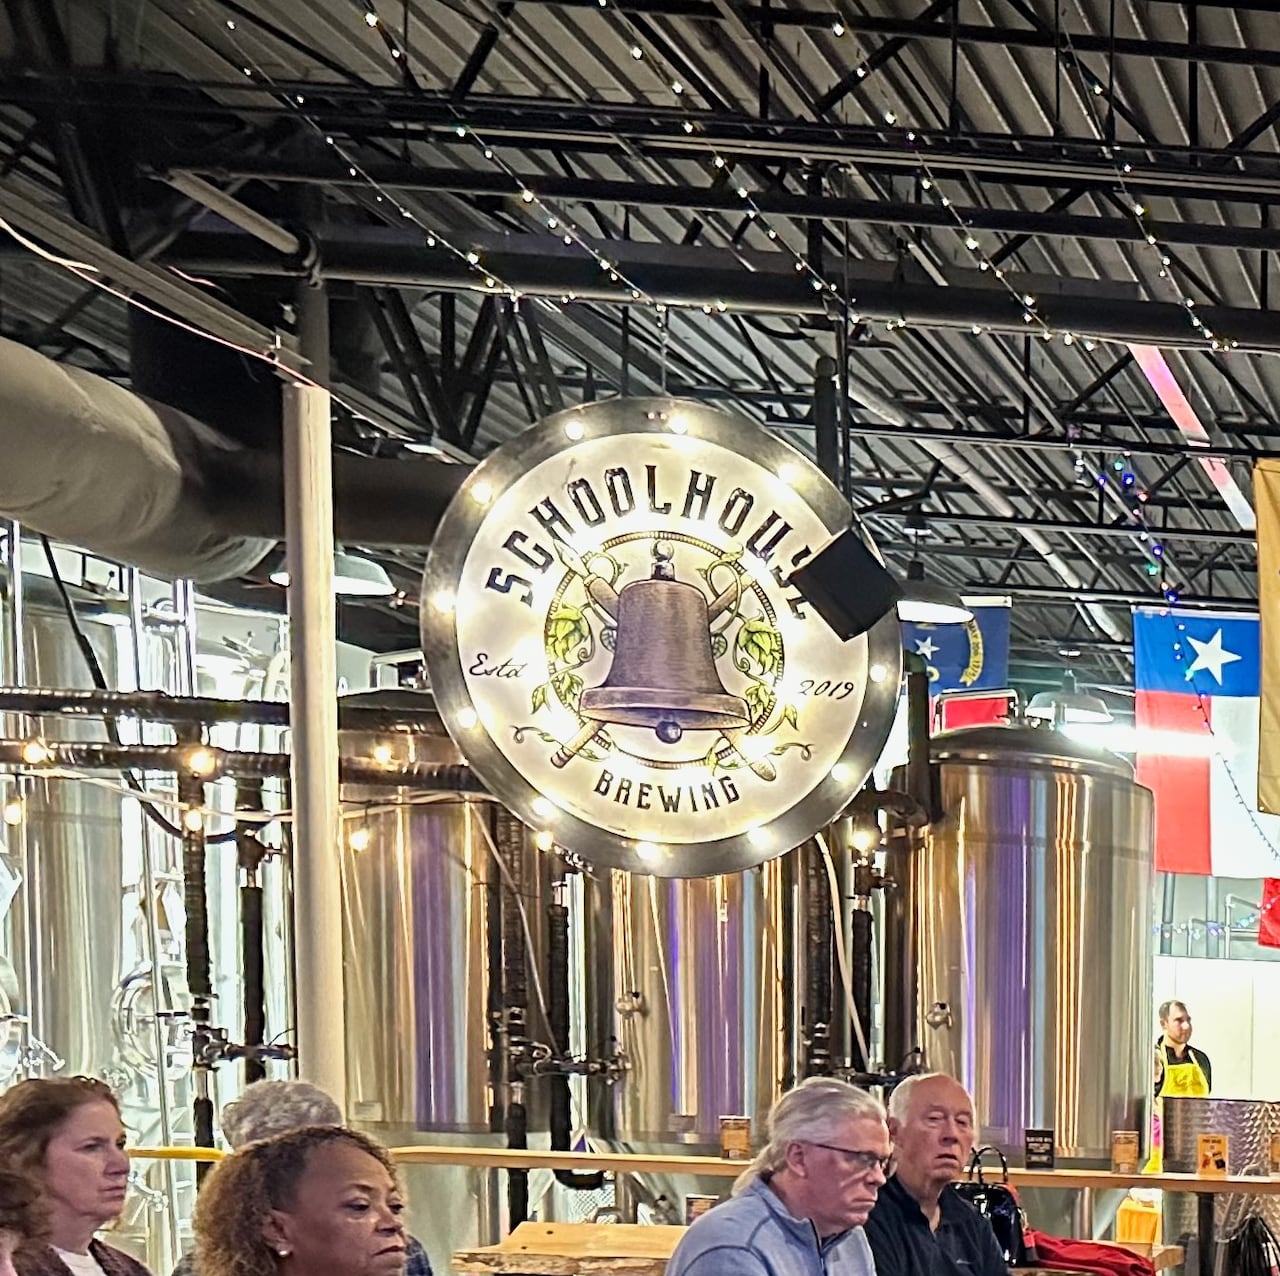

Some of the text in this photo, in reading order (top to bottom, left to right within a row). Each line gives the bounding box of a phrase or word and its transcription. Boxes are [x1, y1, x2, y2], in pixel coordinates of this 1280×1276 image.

[469, 652, 528, 679] Estd
[797, 679, 855, 700] 2019
[593, 769, 740, 813] BREWING
